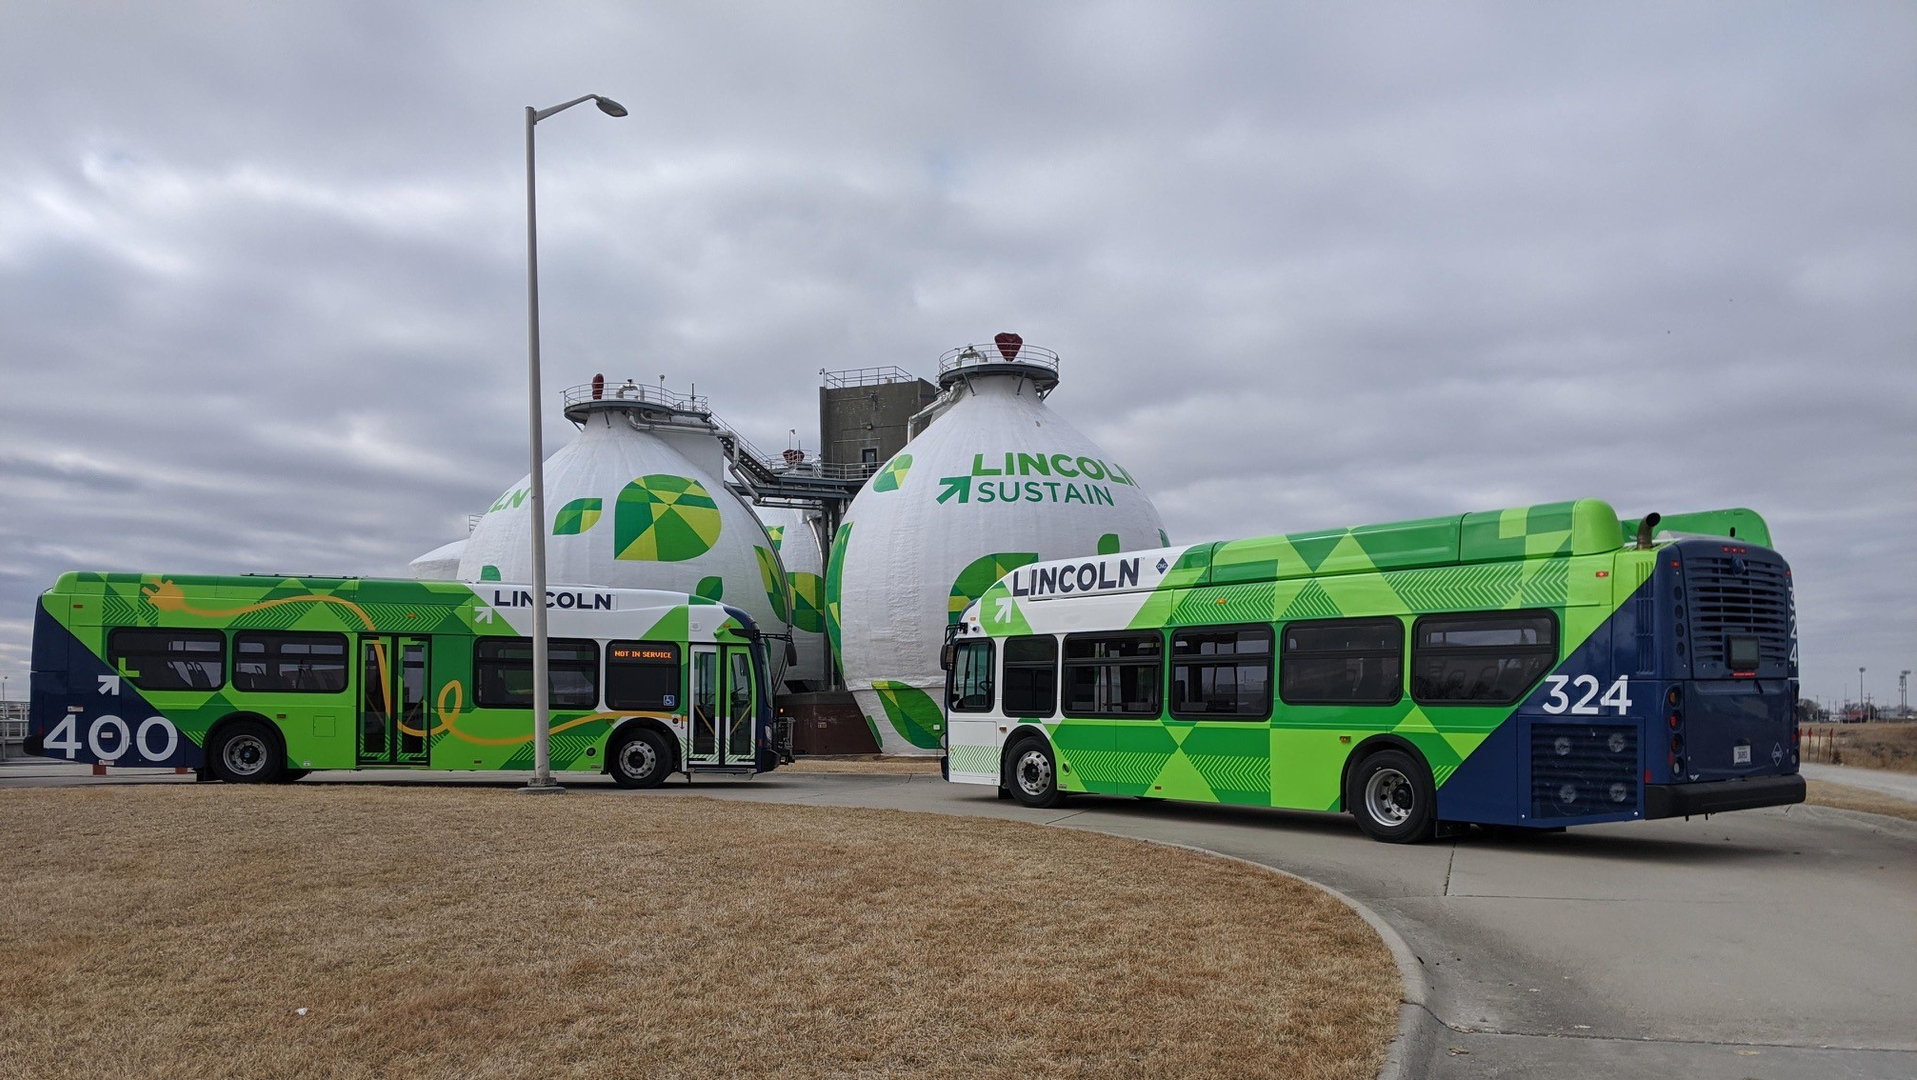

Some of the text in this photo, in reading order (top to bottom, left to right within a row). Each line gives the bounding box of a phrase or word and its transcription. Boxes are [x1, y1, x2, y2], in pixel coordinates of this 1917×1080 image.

[977, 481, 1115, 507] SUSTAIN
[1012, 557, 1140, 597] LINCOLN
[642, 651, 672, 659] SERVICE
[1542, 674, 1633, 716] 324
[43, 714, 178, 762] 400
